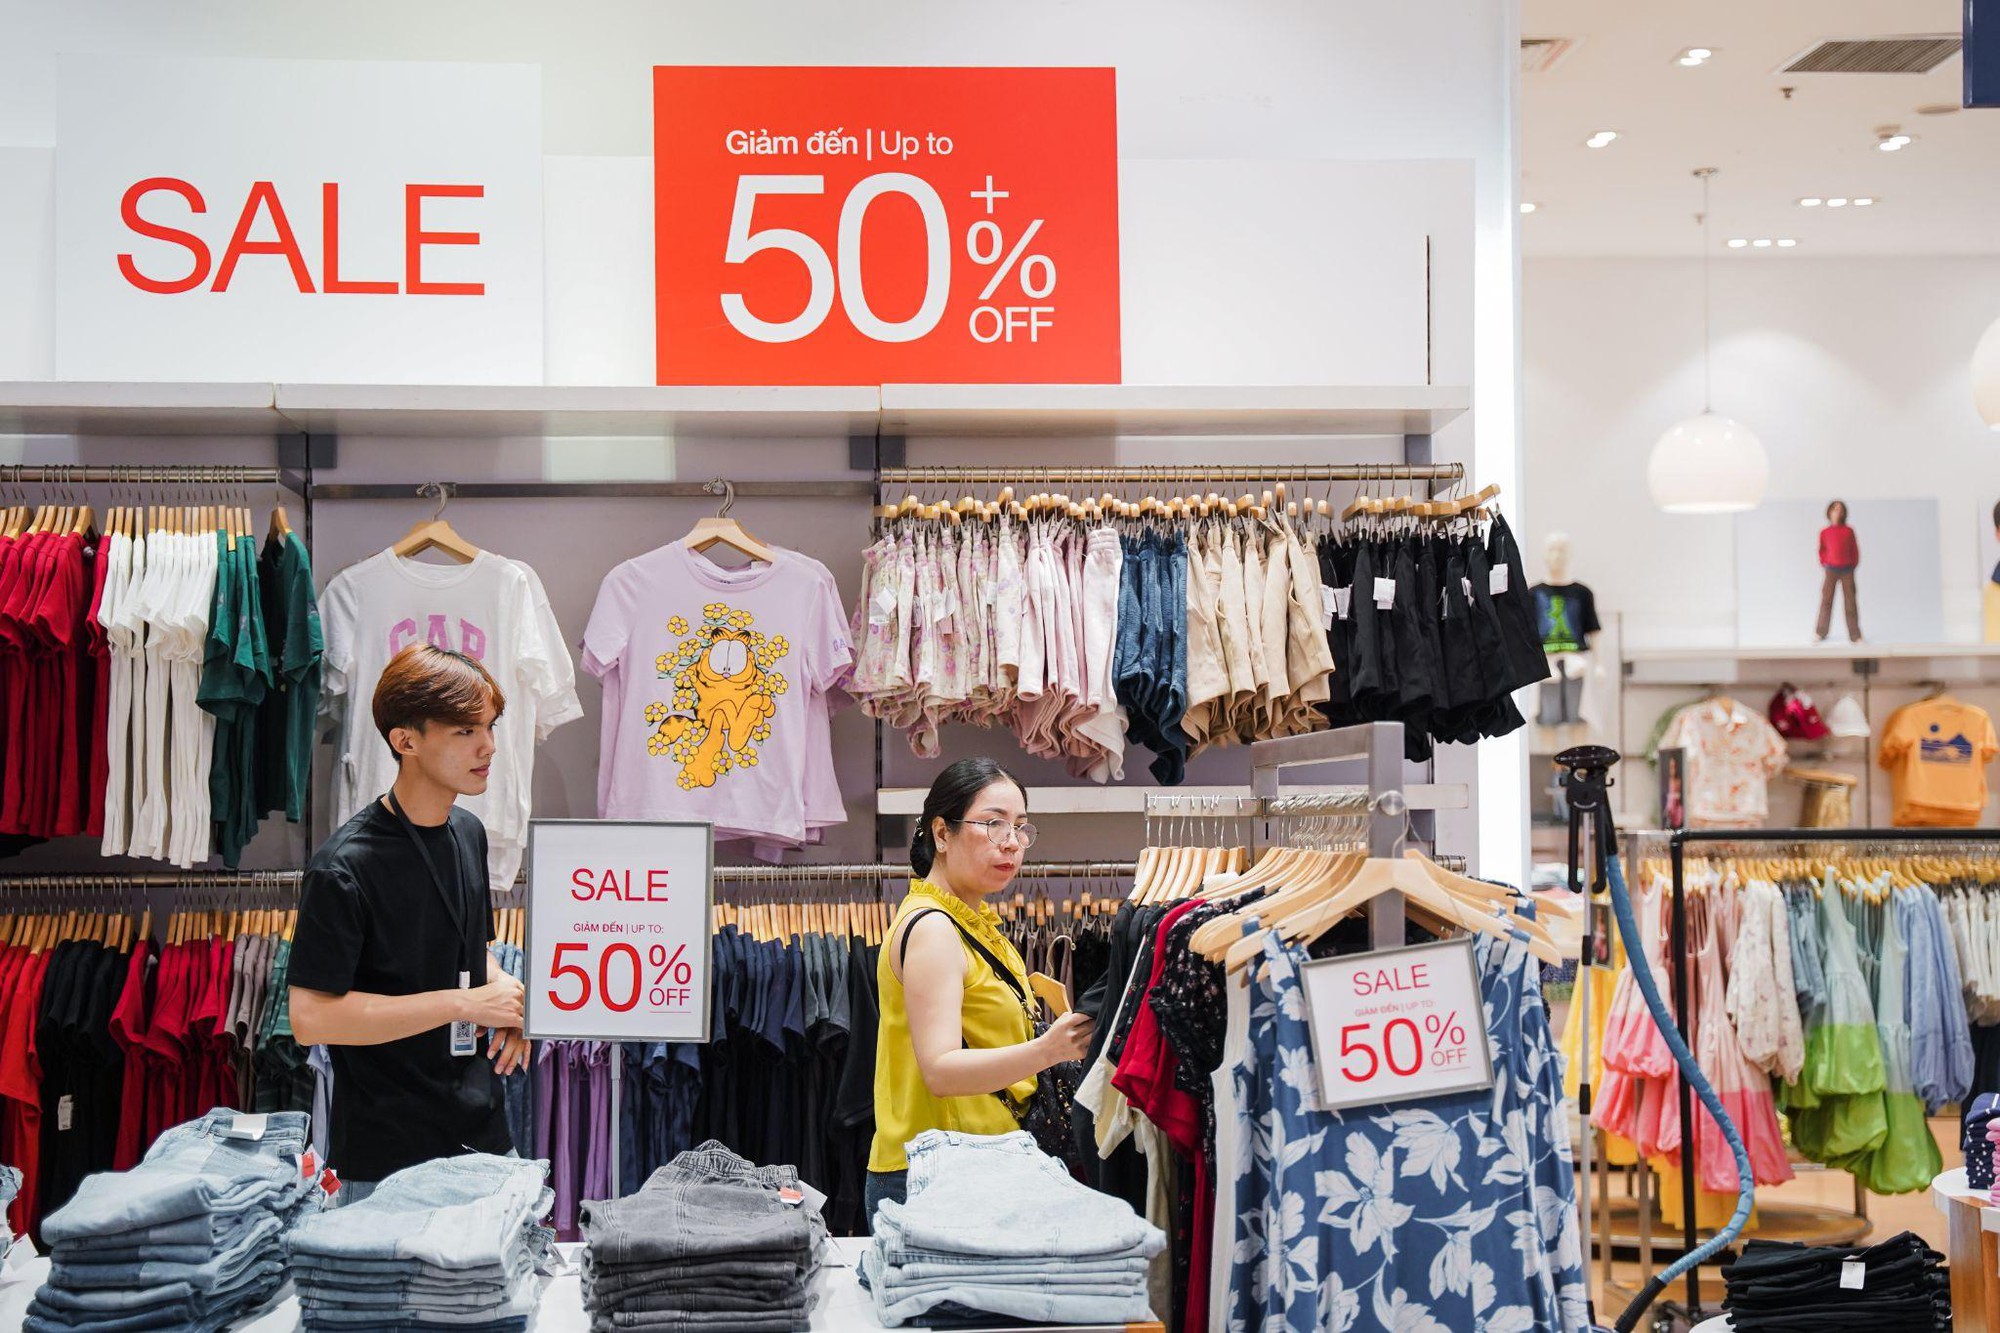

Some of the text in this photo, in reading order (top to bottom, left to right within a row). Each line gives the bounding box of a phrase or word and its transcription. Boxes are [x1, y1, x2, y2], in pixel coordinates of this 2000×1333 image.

[725, 128, 799, 155] Giảm
[806, 127, 858, 155] đến
[880, 130, 920, 161] Up
[925, 133, 954, 155] to
[117, 176, 485, 296] SALE
[968, 305, 1055, 343] OFF
[571, 868, 669, 902] SALE
[573, 921, 600, 932] GIẢM
[602, 921, 623, 932] ĐẾN
[631, 924, 645, 934] UP
[648, 924, 664, 934] TO:
[649, 987, 691, 1007] OFF
[1352, 963, 1431, 997] SALE
[1430, 1048, 1468, 1066] OFF
